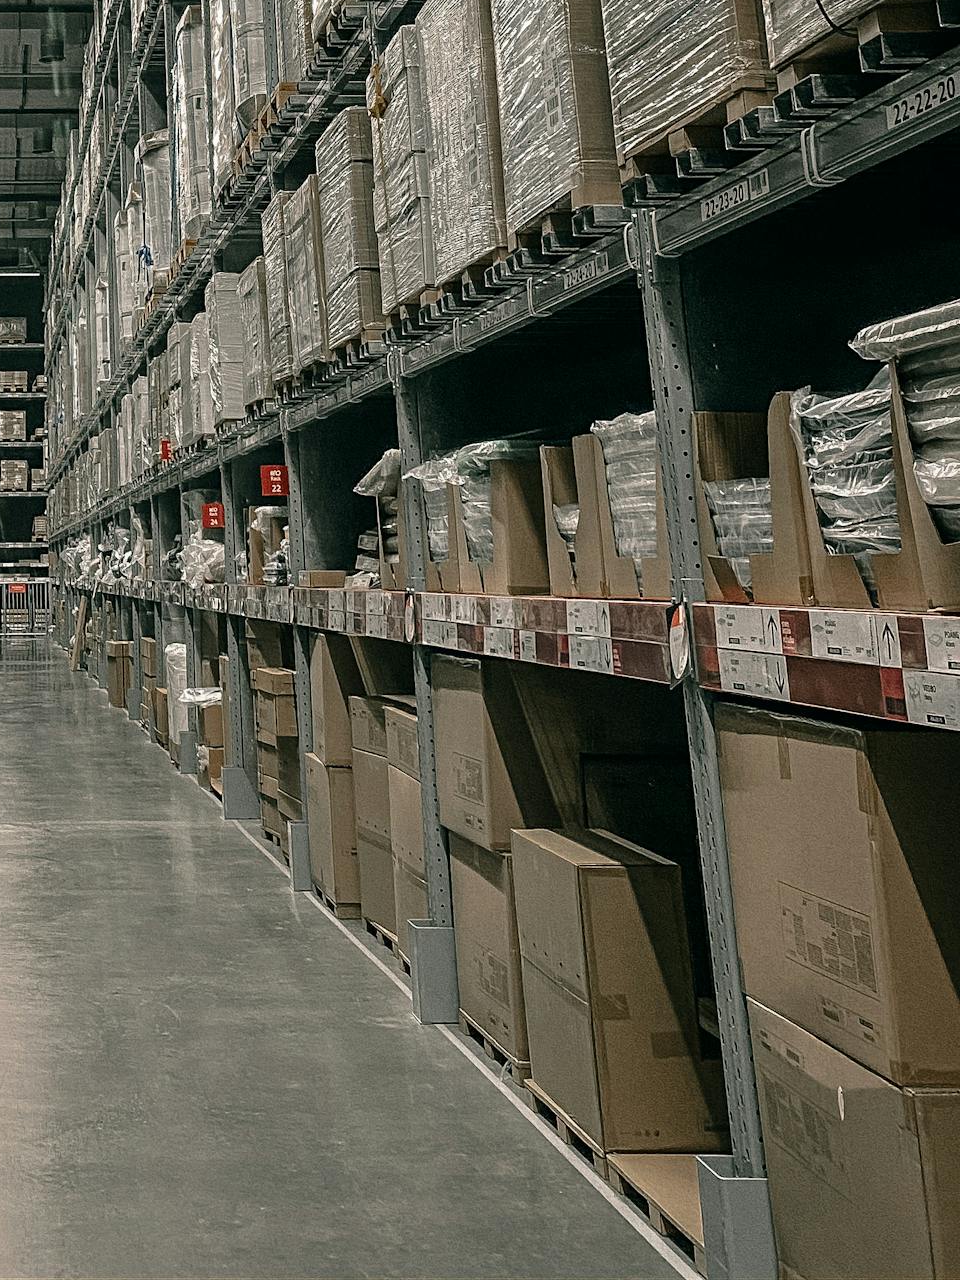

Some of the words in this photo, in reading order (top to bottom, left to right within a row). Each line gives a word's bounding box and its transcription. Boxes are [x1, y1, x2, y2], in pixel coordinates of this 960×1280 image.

[892, 76, 956, 125] 22-22-20
[704, 184, 746, 219] 22-23-20
[271, 484, 282, 493] 22
